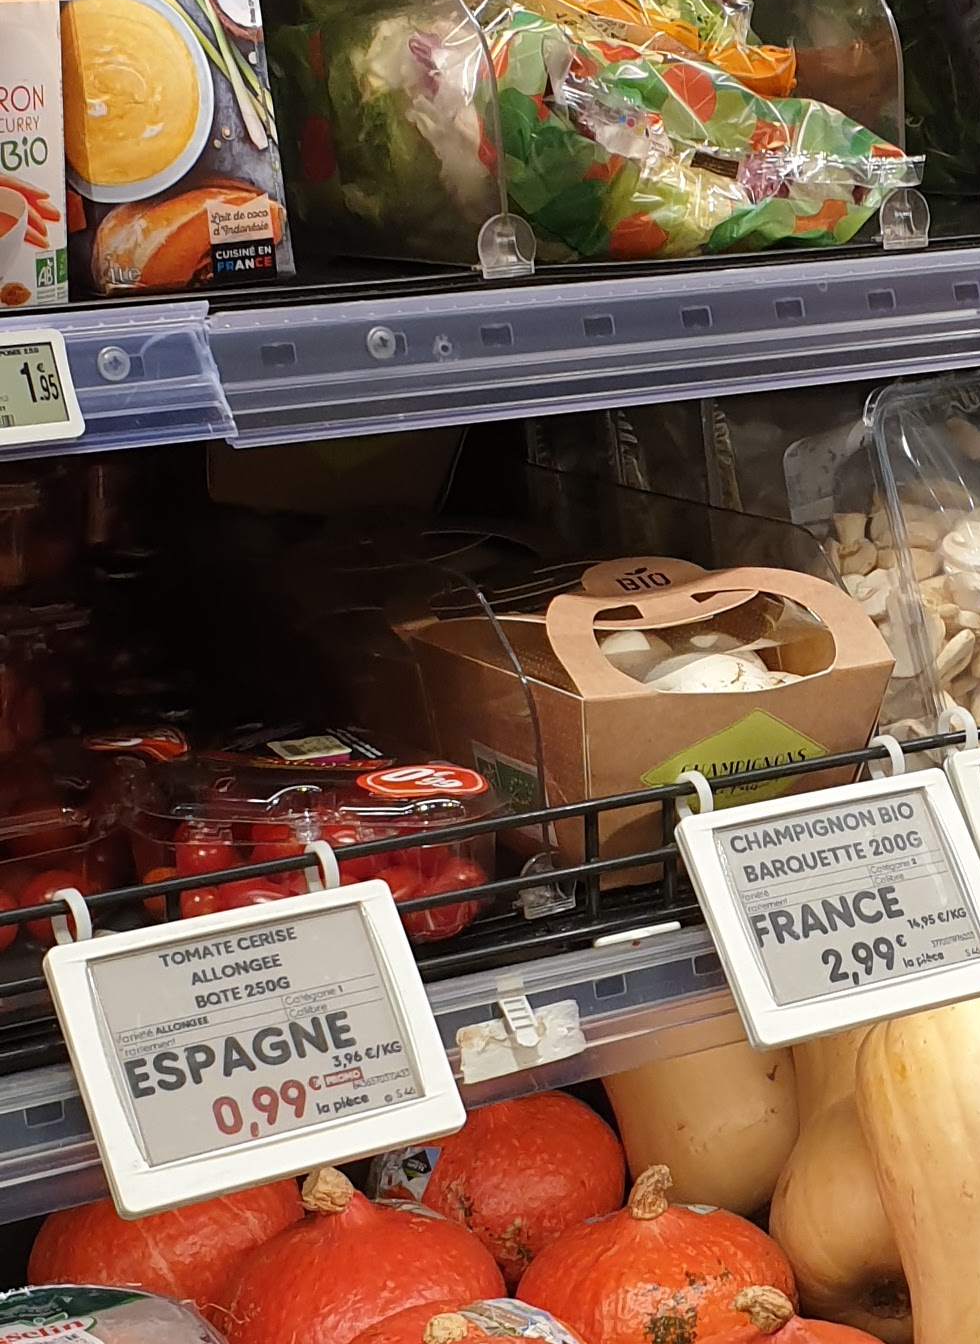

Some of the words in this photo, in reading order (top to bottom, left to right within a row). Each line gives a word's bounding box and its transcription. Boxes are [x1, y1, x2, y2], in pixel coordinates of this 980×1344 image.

[215, 246, 254, 262] CUISINÉ
[256, 245, 274, 257] EN
[216, 256, 274, 272] FRANCE
[615, 570, 672, 593] BIO
[730, 811, 873, 855] CHAMPIGNON
[876, 802, 915, 828] BIO
[743, 841, 867, 885] BARQUETTE
[871, 830, 924, 860] 200G
[750, 886, 905, 949] FRANCE
[907, 914, 937, 931] 14,95
[937, 907, 968, 927] €/KG
[159, 941, 235, 970] TOMATE
[237, 926, 298, 953] CERISE
[917, 951, 946, 970] pièce
[191, 954, 283, 987] ALLONGEE
[195, 987, 241, 1010] BQTE
[244, 976, 291, 999] 250G
[123, 1011, 358, 1100] ESPAGNE
[333, 1050, 363, 1069] 3,96
[365, 1040, 403, 1058] €/KG
[333, 1092, 370, 1115] pièce
